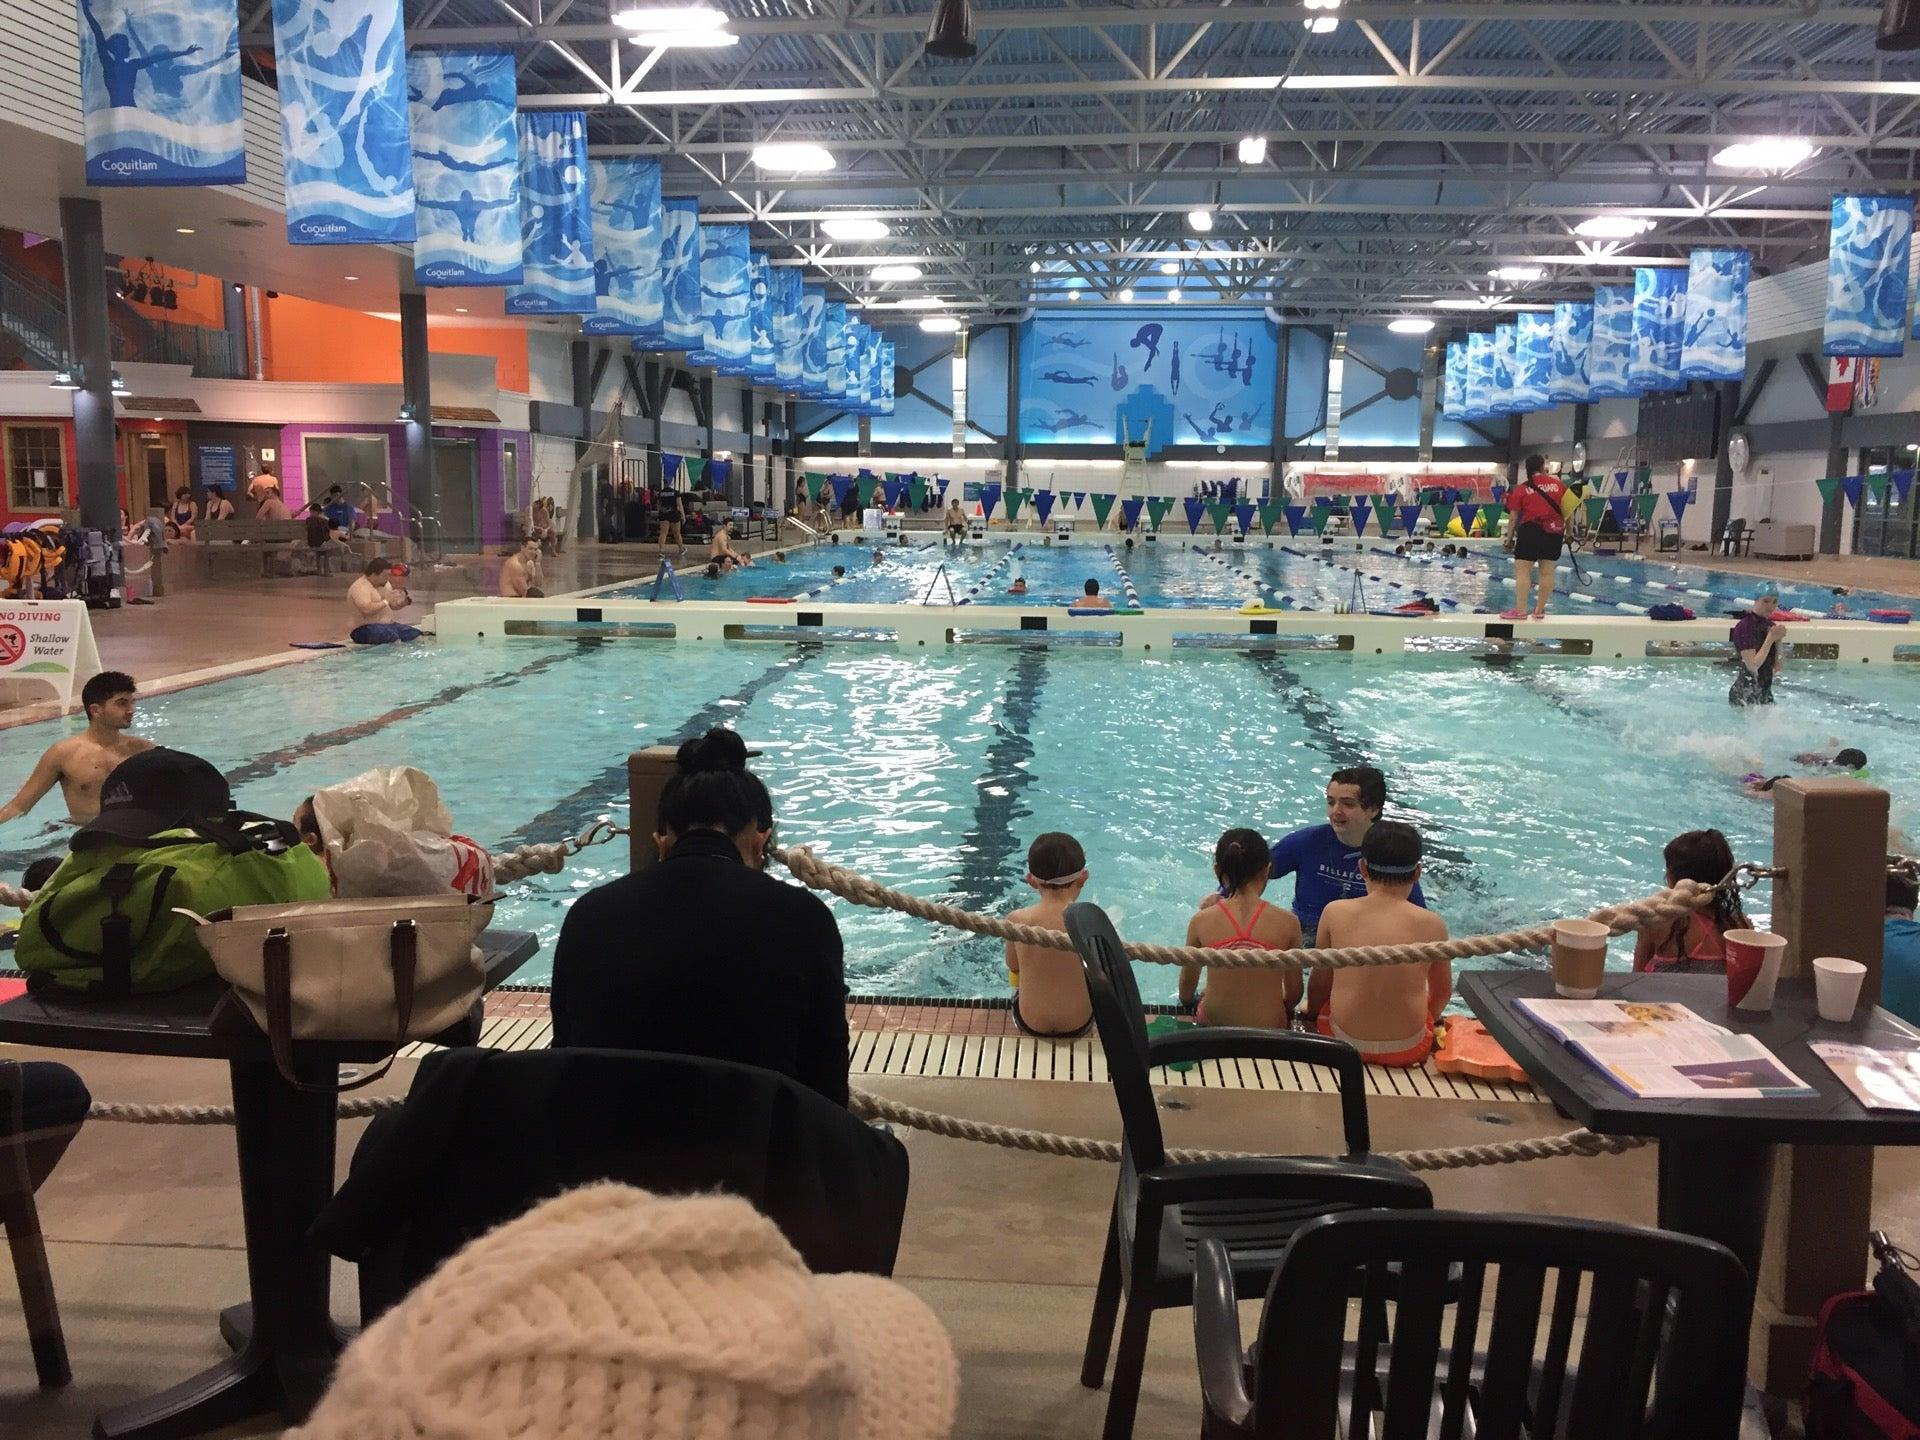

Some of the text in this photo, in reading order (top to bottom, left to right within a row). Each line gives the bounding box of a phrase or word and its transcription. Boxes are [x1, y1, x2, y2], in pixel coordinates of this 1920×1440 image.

[18, 612, 61, 621] DIVING
[30, 633, 70, 643] Shallow
[34, 646, 64, 656] Water
